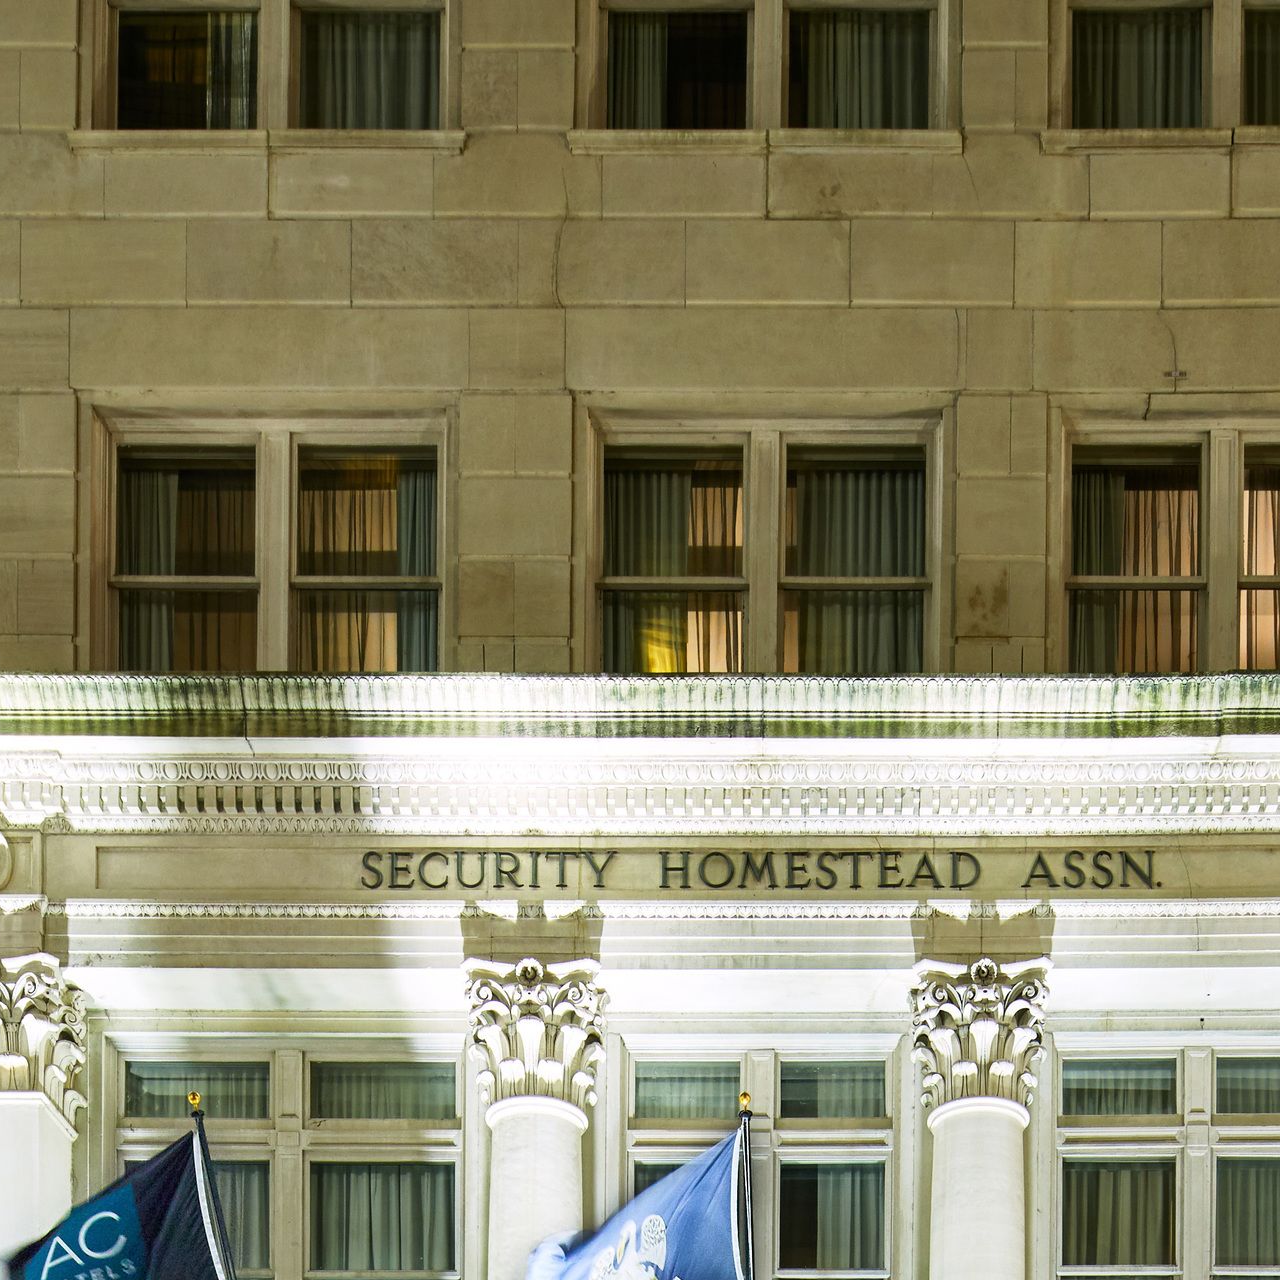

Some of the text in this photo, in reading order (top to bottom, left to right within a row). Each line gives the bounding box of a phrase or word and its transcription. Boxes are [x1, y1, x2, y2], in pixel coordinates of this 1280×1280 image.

[361, 850, 1163, 889] SECURITY HOMESTEAD ASSN.
[40, 1211, 127, 1280] AC
